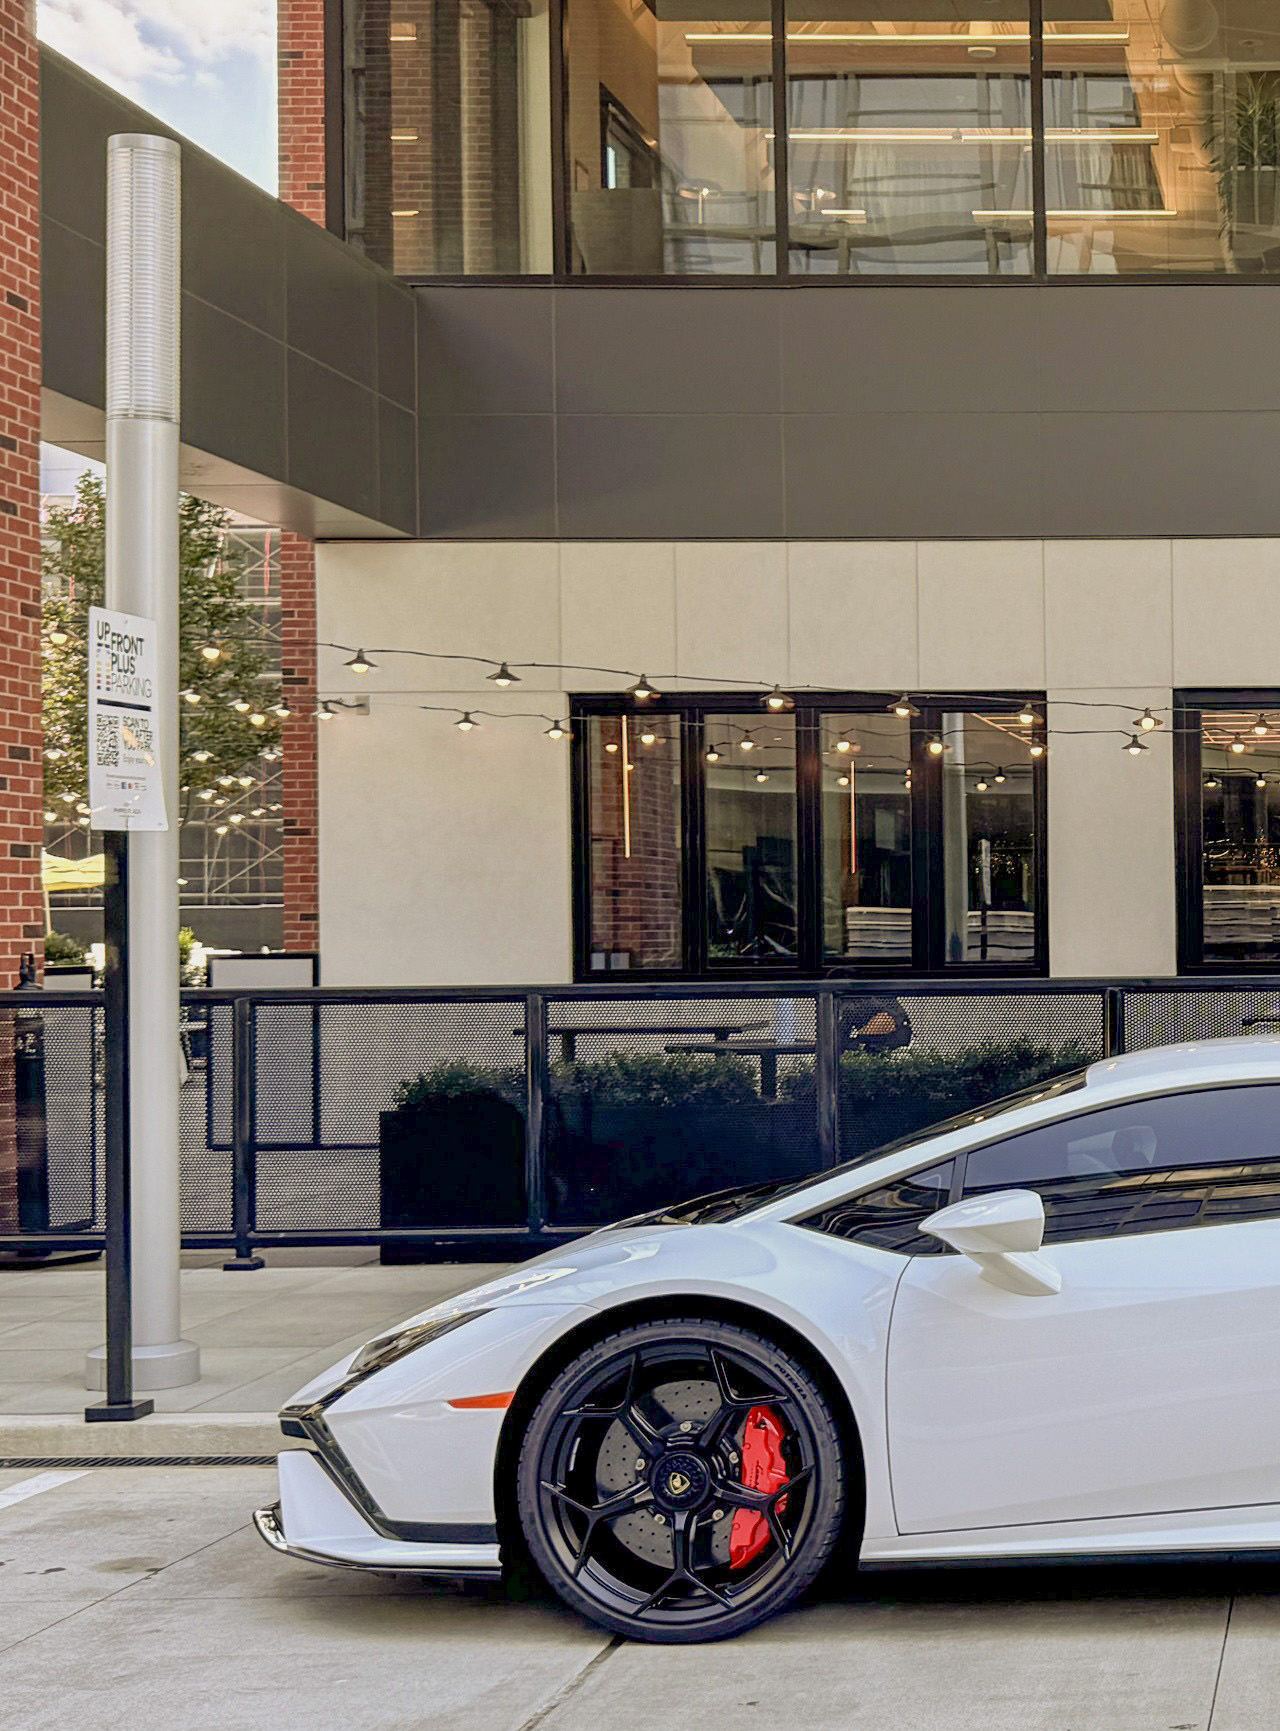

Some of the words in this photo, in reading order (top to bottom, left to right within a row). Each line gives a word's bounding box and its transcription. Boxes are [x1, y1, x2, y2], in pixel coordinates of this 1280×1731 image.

[97, 620, 111, 641] UP
[111, 632, 145, 656] FRONT
[111, 652, 136, 675] PLUS
[111, 673, 152, 698] PARKING
